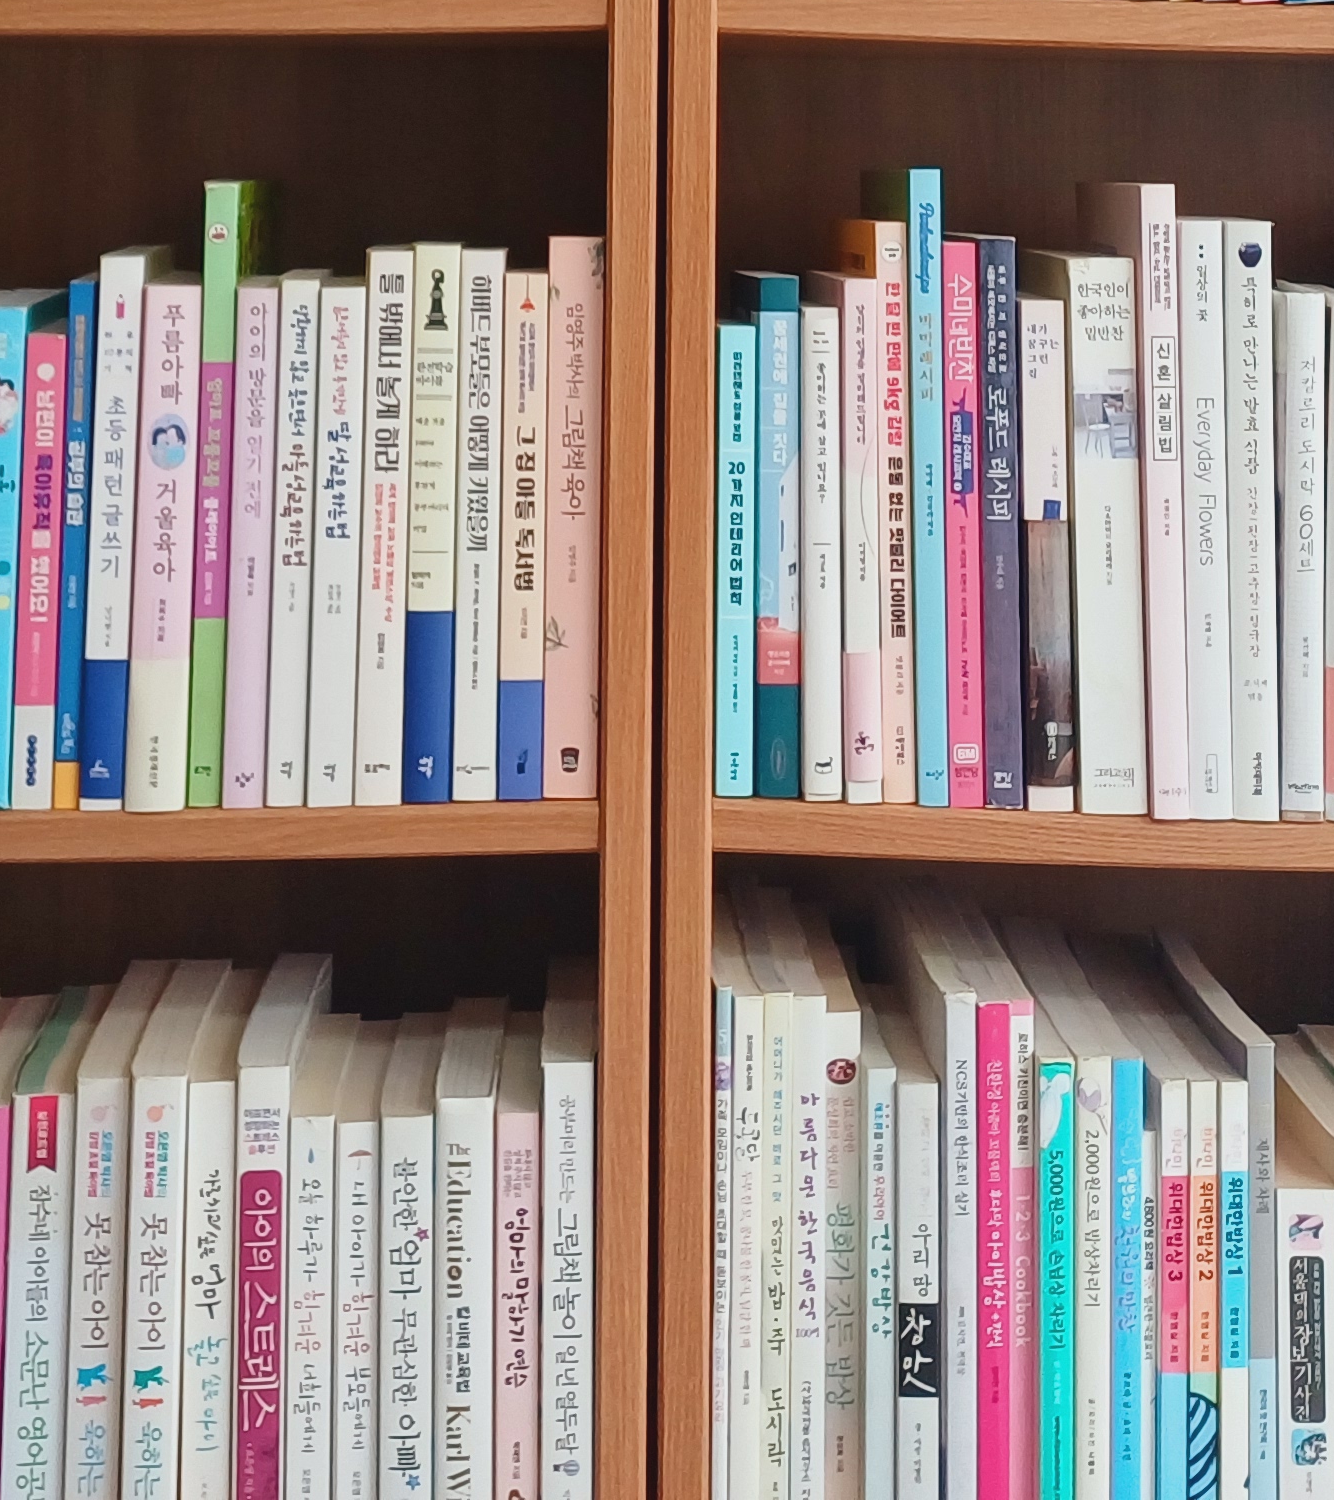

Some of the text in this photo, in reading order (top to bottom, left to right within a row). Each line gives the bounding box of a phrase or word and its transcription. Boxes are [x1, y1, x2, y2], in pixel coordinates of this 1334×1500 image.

[374, 376, 402, 420] 놀게
[377, 302, 404, 369] 밖에서
[373, 426, 401, 474] 하라
[986, 384, 1013, 522] 로푸드 레시피
[1192, 397, 1217, 567] Everyday Flowers
[77, 1212, 111, 1495] 못 참는 아이 욱하는
[132, 1213, 167, 1498] 못 참는 아이 욱하는
[238, 1189, 280, 1432] 아이의 스트레스
[502, 1208, 530, 1389] 엄마의 말하기 연습
[444, 1405, 471, 1463] Karl
